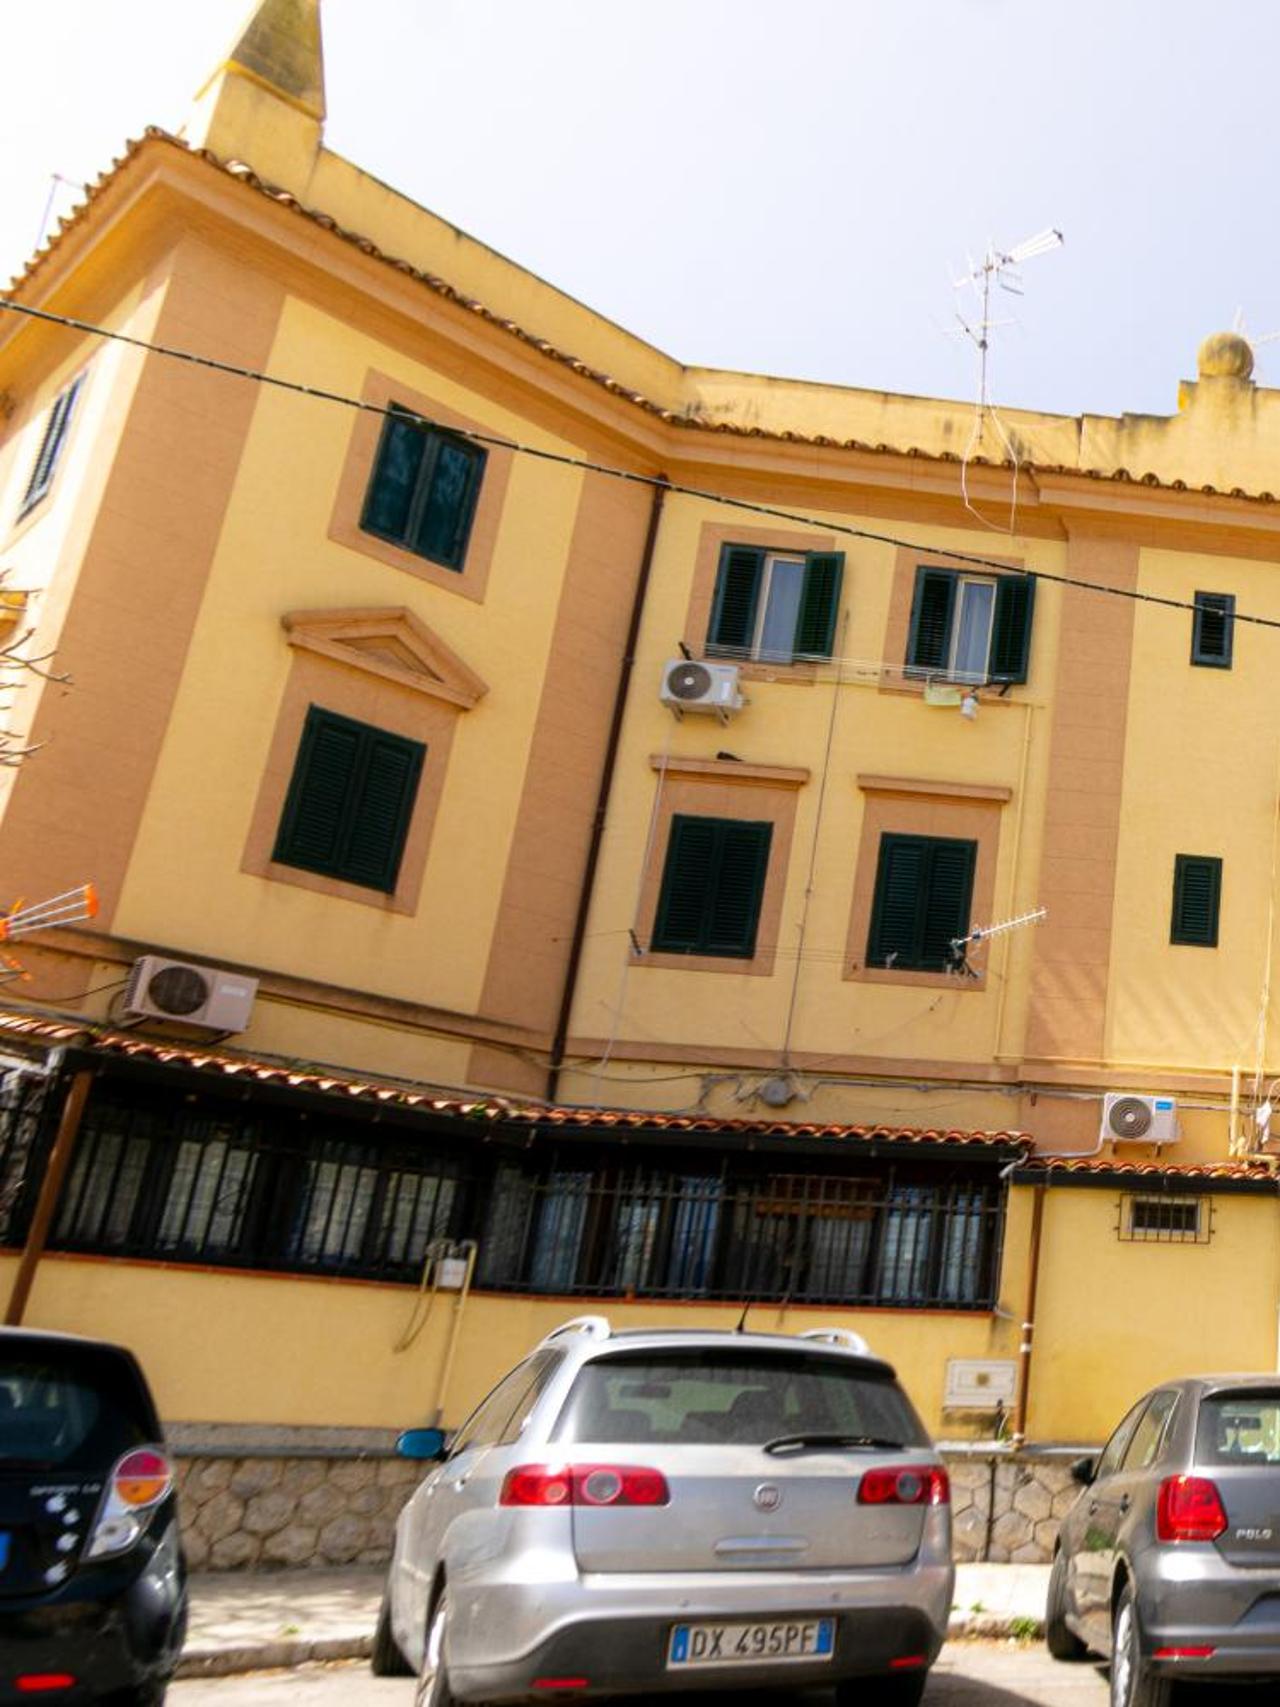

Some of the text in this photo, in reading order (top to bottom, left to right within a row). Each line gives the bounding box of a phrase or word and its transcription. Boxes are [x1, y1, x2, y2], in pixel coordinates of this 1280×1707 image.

[1235, 1528, 1272, 1540] POLO
[690, 1628, 724, 1658] DX
[734, 1623, 816, 1655] 495PF
